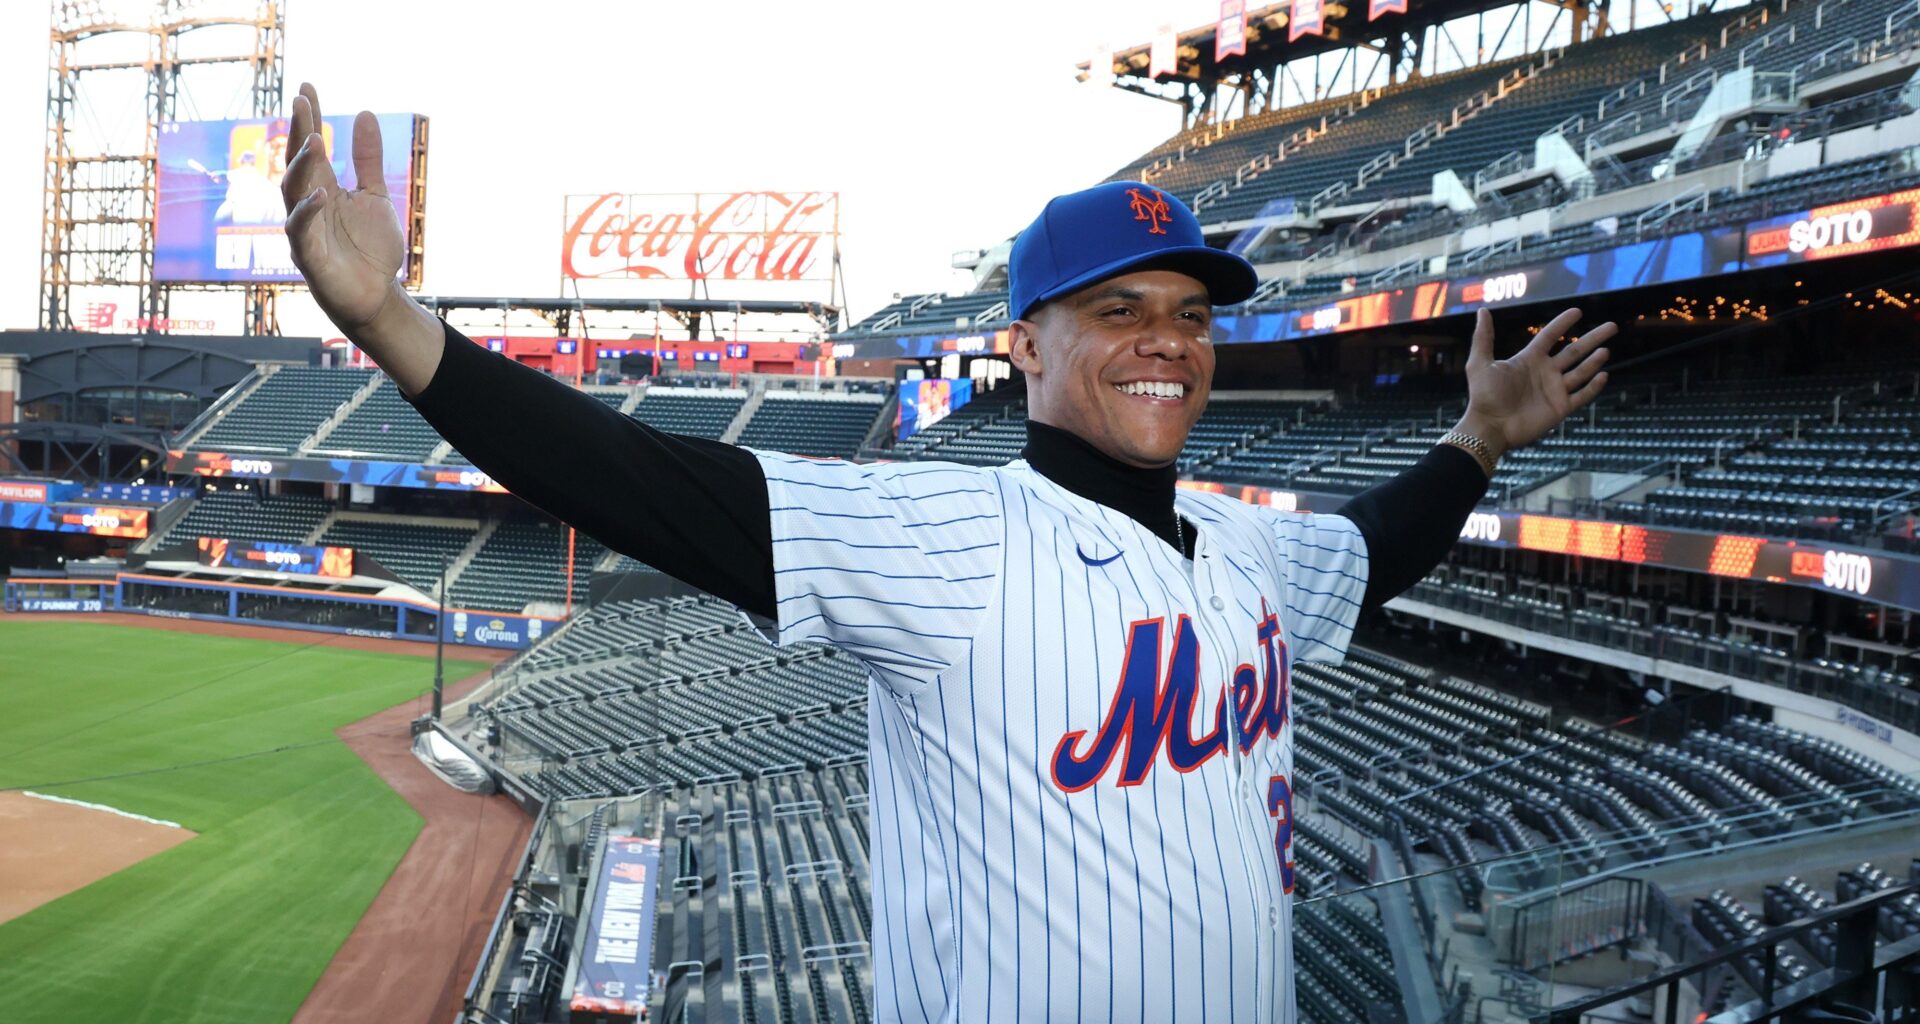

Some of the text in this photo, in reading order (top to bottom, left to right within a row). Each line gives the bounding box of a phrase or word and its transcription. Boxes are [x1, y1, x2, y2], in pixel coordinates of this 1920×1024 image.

[562, 191, 826, 280] Coca-Cola
[1788, 209, 1872, 253] SOTO
[1483, 272, 1527, 303] SOTO
[231, 459, 272, 474] SOTO
[460, 472, 499, 486] SOT
[1460, 512, 1501, 541] OTO
[265, 552, 300, 565] SOTO
[1823, 550, 1871, 595] SOTO
[83, 601, 101, 611] 370
[345, 628, 392, 639] CADILLAC
[474, 626, 518, 644] Corona
[1268, 775, 1295, 894] 2
[604, 881, 644, 909] YORK
[599, 910, 640, 940] NEW
[595, 938, 638, 964] THE
